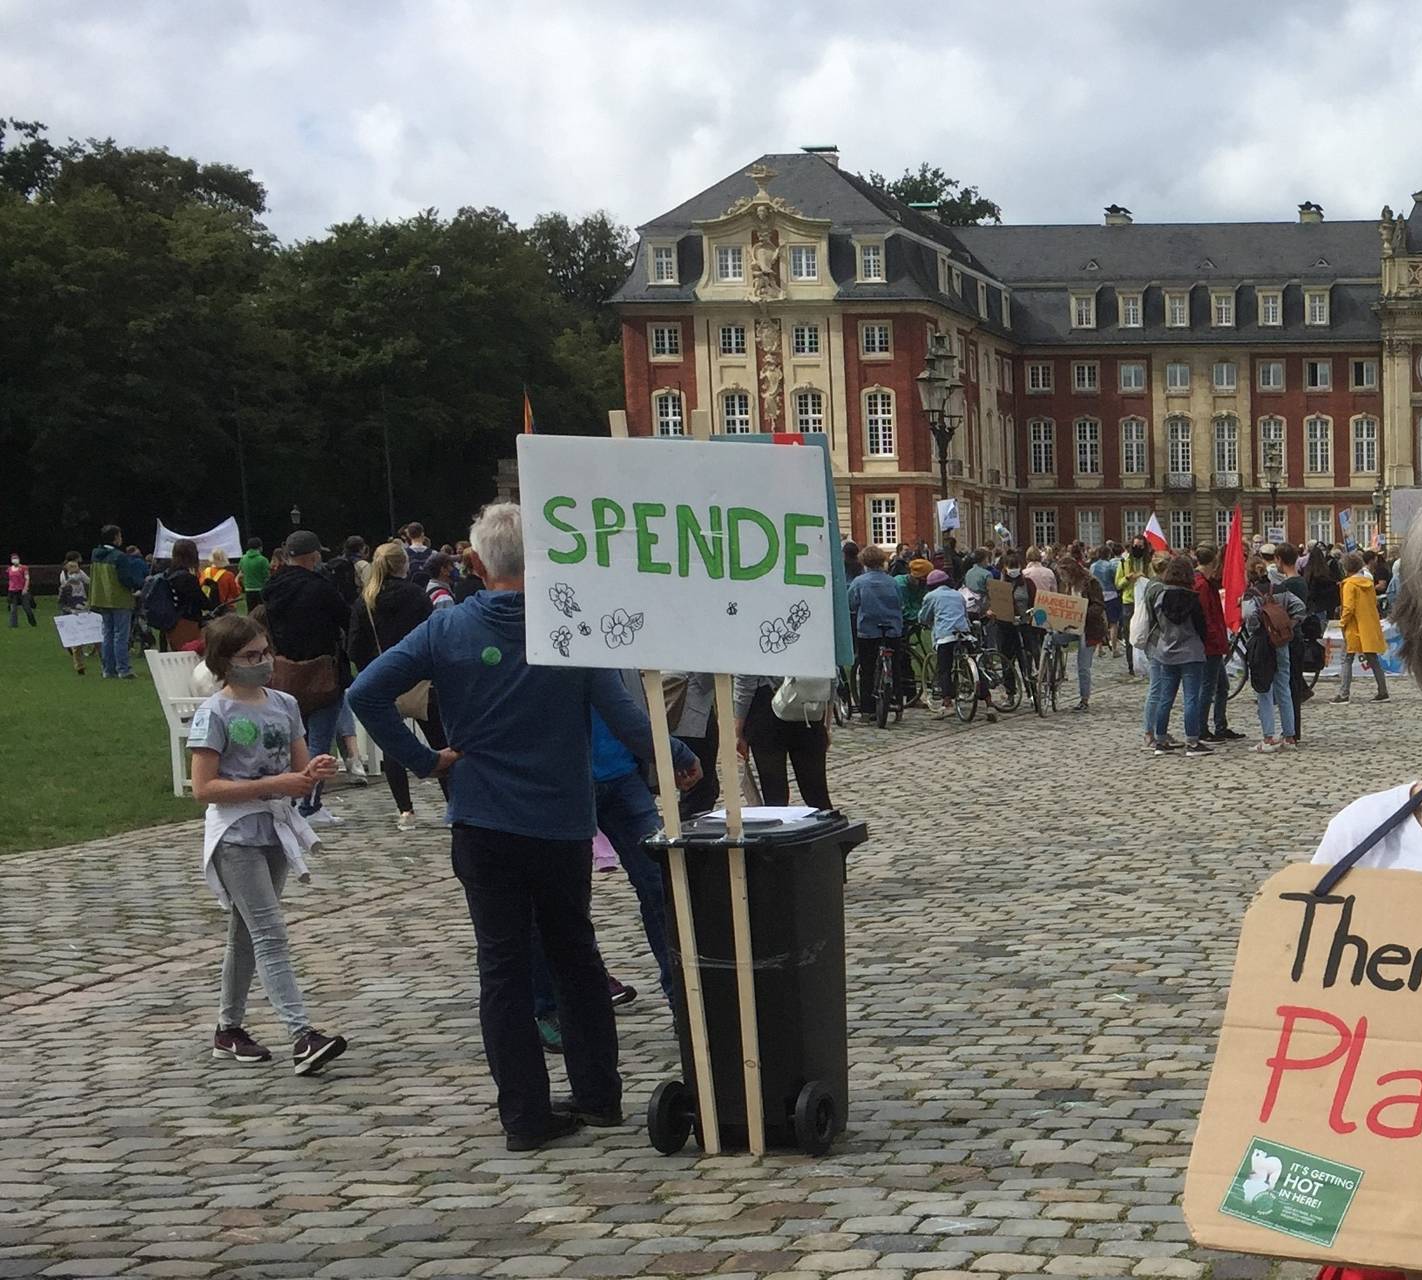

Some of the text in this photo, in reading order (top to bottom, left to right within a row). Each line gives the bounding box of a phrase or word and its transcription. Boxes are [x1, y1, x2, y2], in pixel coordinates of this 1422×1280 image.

[543, 495, 826, 587] SPENDE
[1283, 1172, 1324, 1197] HOT
[1290, 1162, 1354, 1190] IT'S GETTING
[1278, 1188, 1292, 1200] IN
[1291, 1192, 1322, 1209] HERE!
